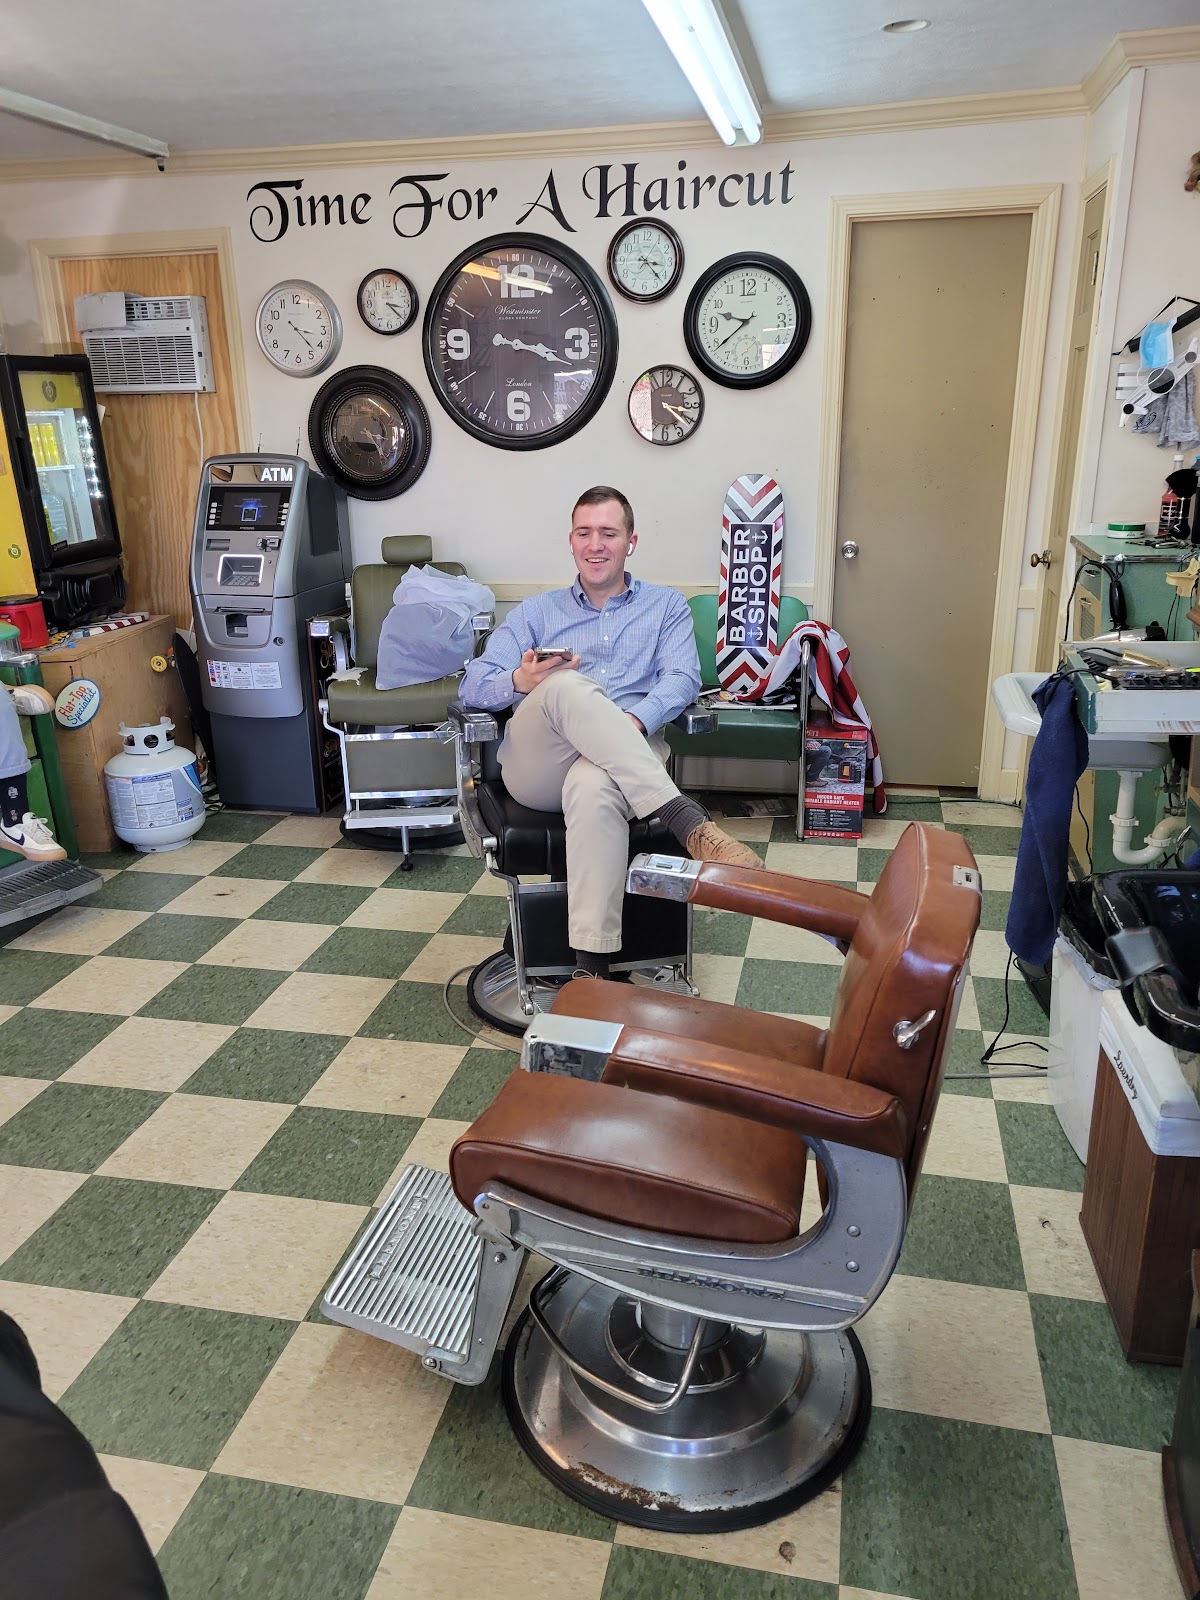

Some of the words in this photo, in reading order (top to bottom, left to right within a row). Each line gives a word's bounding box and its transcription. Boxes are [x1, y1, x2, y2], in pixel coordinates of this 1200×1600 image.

[246, 178, 372, 242] Time
[389, 172, 498, 238] For
[515, 168, 578, 232] A
[582, 159, 796, 218] Haircut
[633, 234, 639, 244] 11
[643, 231, 652, 241] 12
[624, 243, 632, 253] 10
[664, 244, 670, 254] 2
[511, 253, 520, 262] 60
[620, 256, 625, 265] 9
[667, 257, 673, 267] 3
[623, 269, 628, 278] 8
[662, 270, 668, 279] 4
[382, 278, 391, 288] 12
[498, 264, 535, 298] 12
[632, 278, 637, 288] 7
[642, 281, 648, 291] 6
[653, 279, 658, 288] 5
[725, 284, 734, 294] 11
[739, 278, 757, 297] 12
[763, 282, 768, 292] 1
[400, 288, 407, 297] 2
[280, 299, 286, 309] 11
[292, 294, 301, 304] 12
[366, 299, 372, 308] 9
[447, 297, 456, 307] 50
[579, 295, 588, 306] 10
[713, 299, 723, 309] 10
[776, 296, 783, 305] 2
[494, 304, 542, 315] Westminster
[270, 310, 280, 320] 10
[315, 310, 322, 320] 2
[369, 310, 376, 320] 8
[386, 320, 393, 329] 6
[709, 316, 718, 334] 9
[777, 312, 787, 330] 3
[266, 324, 274, 334] 9
[320, 325, 327, 335] 3
[272, 340, 279, 349] 8
[317, 340, 323, 349] 4
[440, 339, 447, 349] 45
[447, 328, 471, 361] 9
[564, 327, 590, 360] 3
[590, 338, 598, 348] 15
[713, 338, 719, 347] 8
[284, 349, 290, 359] 7
[295, 354, 302, 363] 6
[308, 350, 314, 360] 5
[725, 351, 730, 360] 7
[743, 357, 749, 366] 6
[505, 378, 533, 387] London
[660, 369, 673, 387] 12
[450, 381, 459, 391] 40
[680, 387, 698, 399] 2
[506, 390, 531, 422] 6
[515, 423, 524, 431] 30
[673, 421, 684, 437] 5
[661, 424, 669, 441] 6
[260, 468, 293, 482] ATM
[729, 528, 751, 642] BARBER
[747, 546, 768, 624] SHOP
[58, 686, 87, 717] Flat-Top
[67, 687, 96, 724] Specialist
